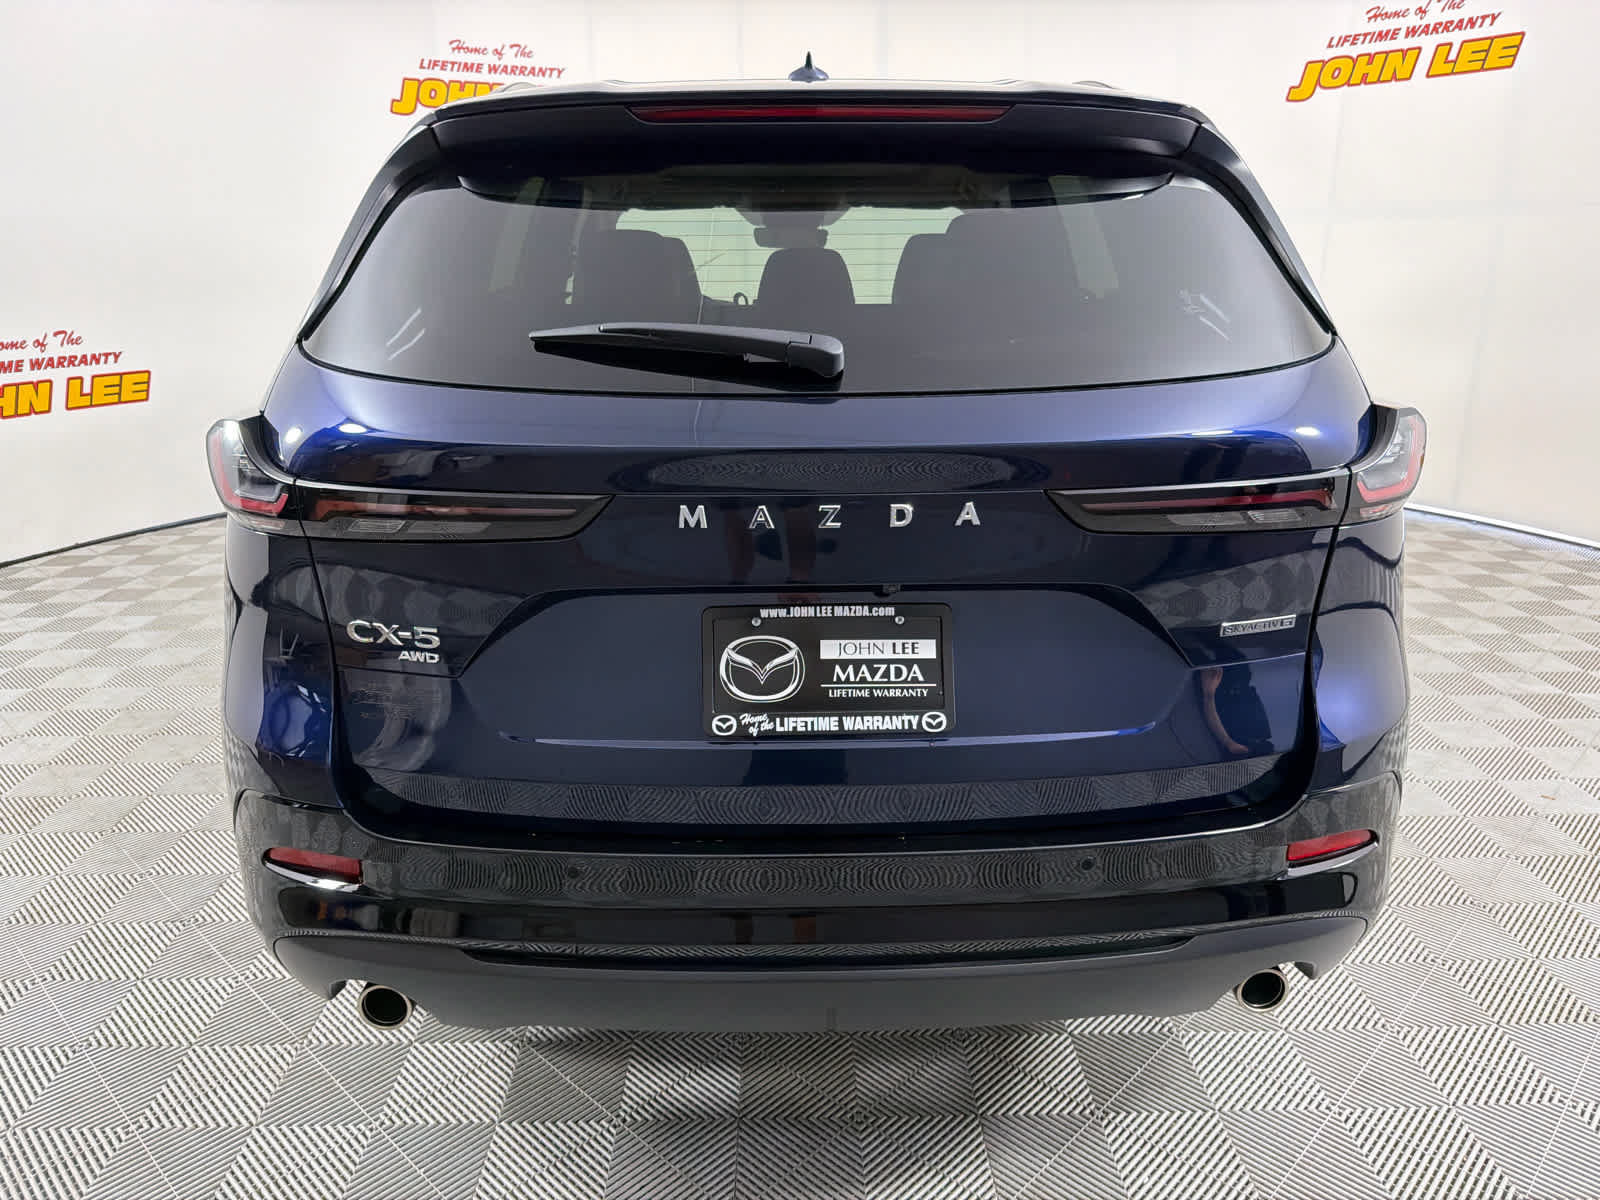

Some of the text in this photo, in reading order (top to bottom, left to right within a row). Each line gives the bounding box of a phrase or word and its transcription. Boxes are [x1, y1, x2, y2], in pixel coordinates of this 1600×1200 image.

[1365, 5, 1411, 24] Home
[1414, 0, 1432, 20] of
[1326, 11, 1502, 49] LIFETIME WARRANTY
[448, 39, 534, 60] Home of The
[418, 57, 566, 79] LIFETIME WARRANTY
[1285, 31, 1526, 102] JOHN LEE
[0, 329, 84, 353] ome of The
[29, 350, 123, 372] WARRANTY
[65, 369, 152, 411] LEE
[677, 501, 982, 529] MAZDA
[759, 606, 895, 618] www.JOHN LEE MAZDA.com
[346, 619, 440, 649] CX-5
[398, 650, 440, 664] AWD
[838, 641, 920, 657] JOHN LEE
[832, 664, 925, 683] MAZDA
[828, 687, 929, 698] LIFETIME WARRANTY
[739, 712, 769, 726] Home
[748, 718, 775, 737] of the
[775, 715, 919, 732] LIFETIME WARRANTY
